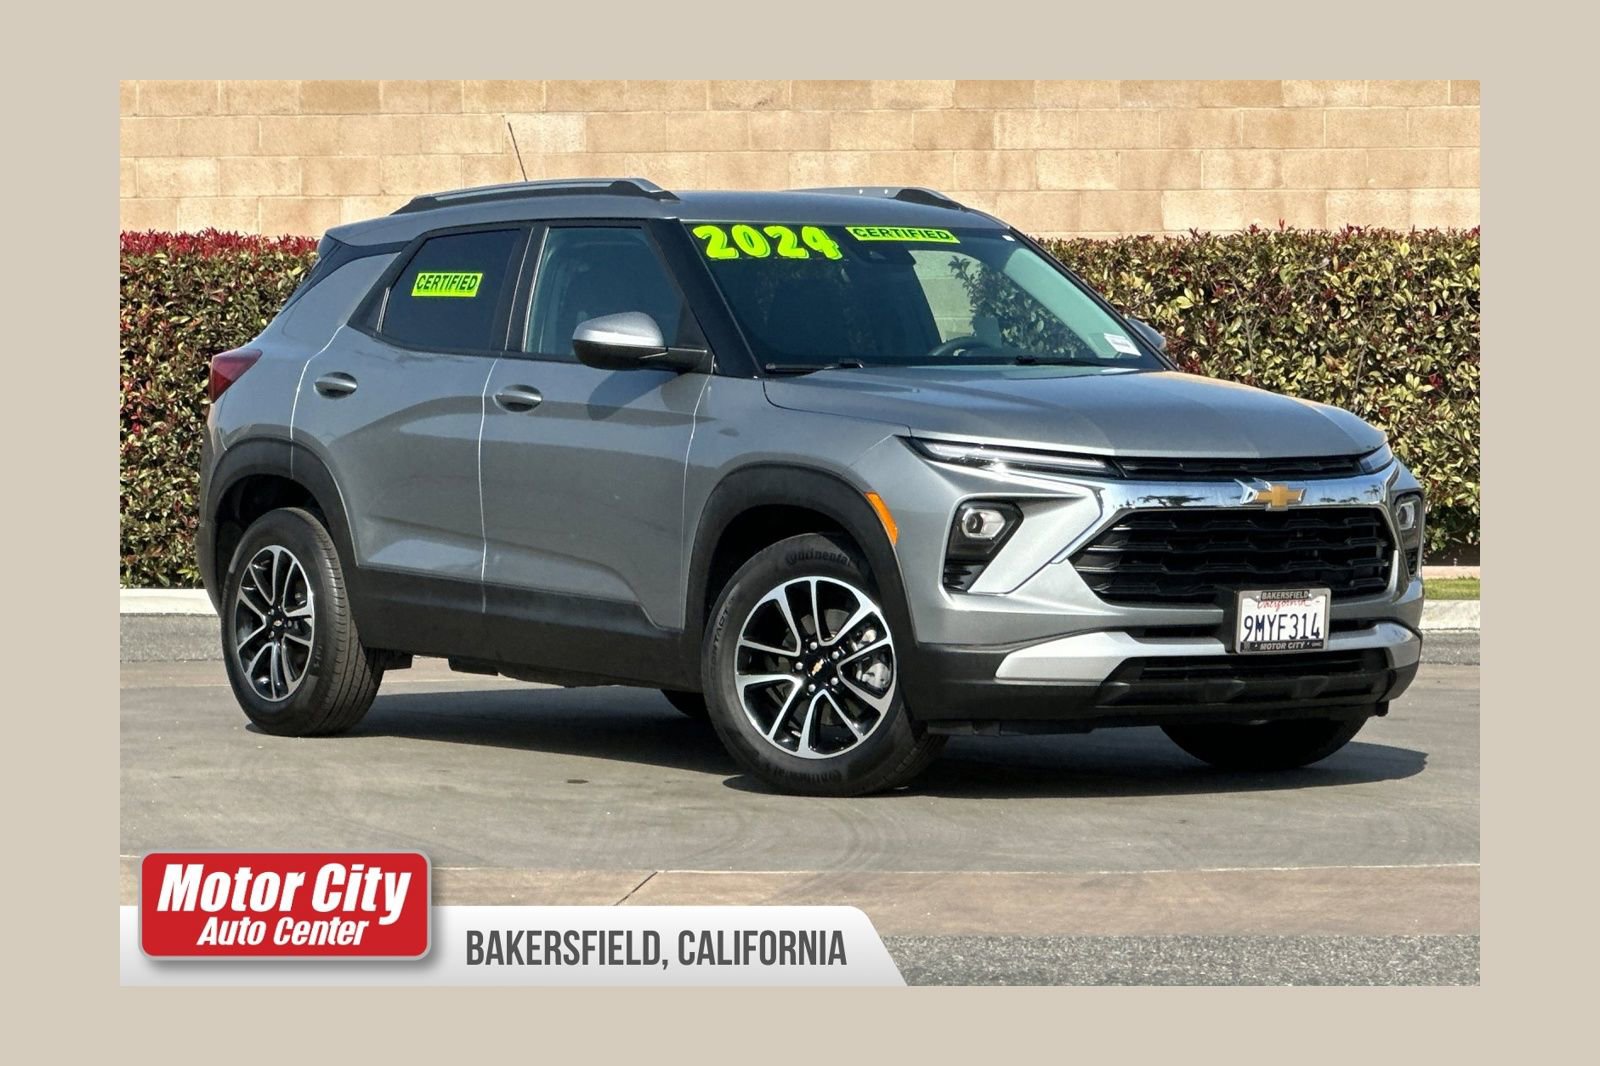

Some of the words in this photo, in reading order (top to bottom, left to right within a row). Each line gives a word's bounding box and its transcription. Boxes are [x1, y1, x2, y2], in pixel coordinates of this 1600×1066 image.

[852, 228, 952, 240] CERTIFIED
[692, 224, 843, 260] 2024
[416, 274, 479, 291] CERTIFIED
[1262, 591, 1309, 600] BAKERSFIELD
[1243, 612, 1321, 642] 9MYF314
[1260, 642, 1287, 650] MOTOR
[1287, 641, 1306, 649] CITY
